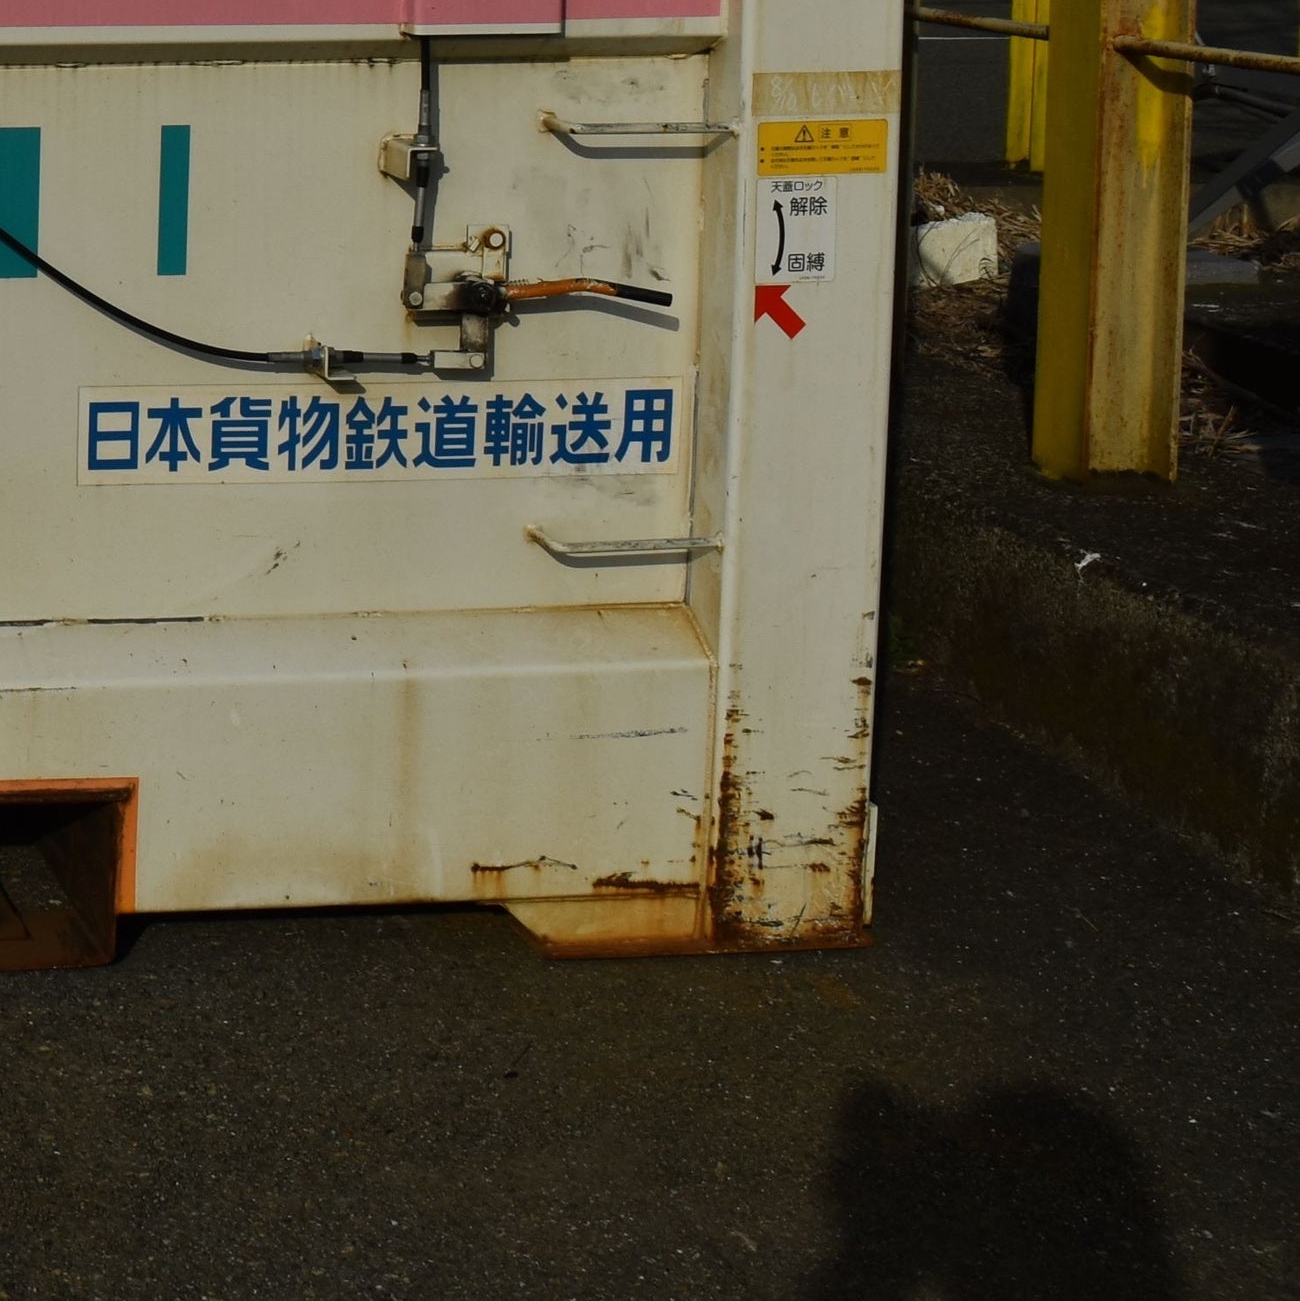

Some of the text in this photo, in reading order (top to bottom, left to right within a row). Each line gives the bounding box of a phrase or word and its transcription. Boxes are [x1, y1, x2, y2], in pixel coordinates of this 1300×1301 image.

[820, 127, 850, 139] 注意
[771, 180, 823, 193] 天蓋ロック
[789, 196, 828, 217] 解除
[787, 252, 826, 273] 固縛
